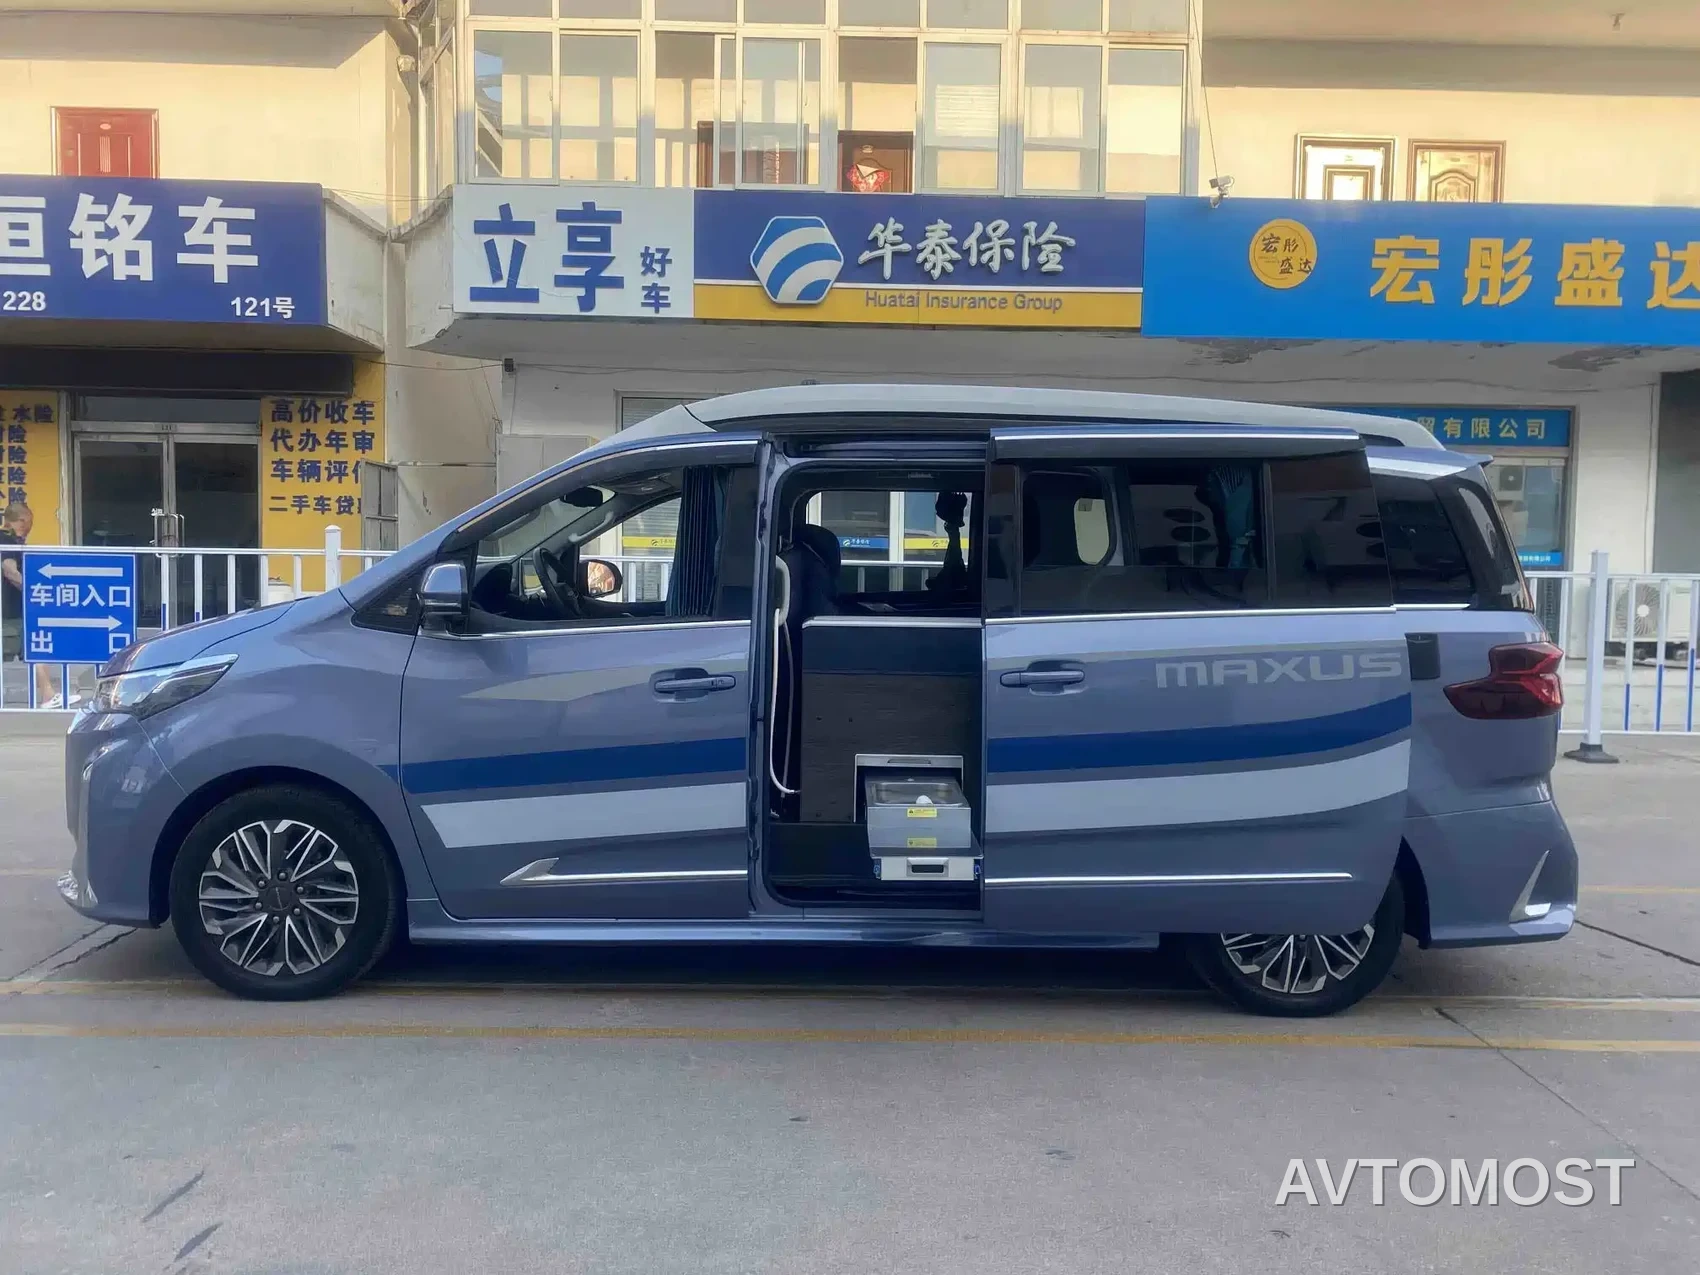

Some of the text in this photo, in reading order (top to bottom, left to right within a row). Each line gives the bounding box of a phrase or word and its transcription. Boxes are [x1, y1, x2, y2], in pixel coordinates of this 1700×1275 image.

[470, 201, 625, 312] 立享
[858, 216, 1076, 280] 华泰保险
[1279, 256, 1312, 274] 盛达
[1370, 235, 1700, 309] 宏彤盛达
[640, 245, 672, 314] 好车
[2, 290, 46, 312] 228
[230, 296, 295, 319] 121号
[865, 290, 1062, 314] Huatai Insurance Group
[269, 399, 375, 425] 高价收车
[0, 424, 27, 443] 险
[270, 428, 375, 454] 代办年审
[0, 445, 27, 464] 险
[0, 466, 27, 485] 险
[269, 495, 361, 515] 二手车贷
[30, 583, 131, 607] 车间入口
[1155, 652, 1402, 689] MAXUS
